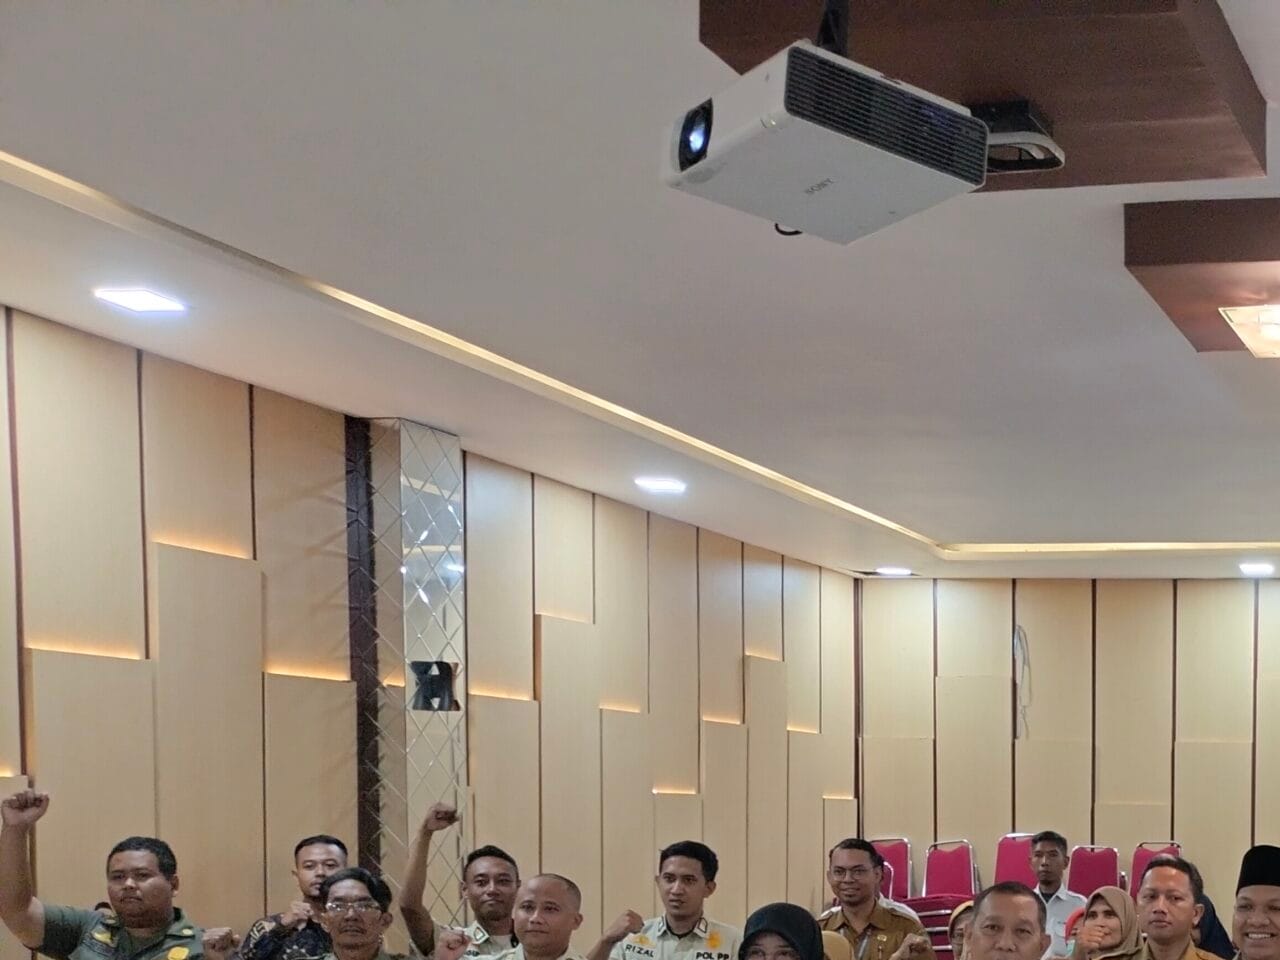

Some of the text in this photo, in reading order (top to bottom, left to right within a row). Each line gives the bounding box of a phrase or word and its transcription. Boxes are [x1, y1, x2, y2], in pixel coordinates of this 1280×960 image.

[625, 944, 654, 958] RIZAL
[696, 951, 730, 960] POL PP
